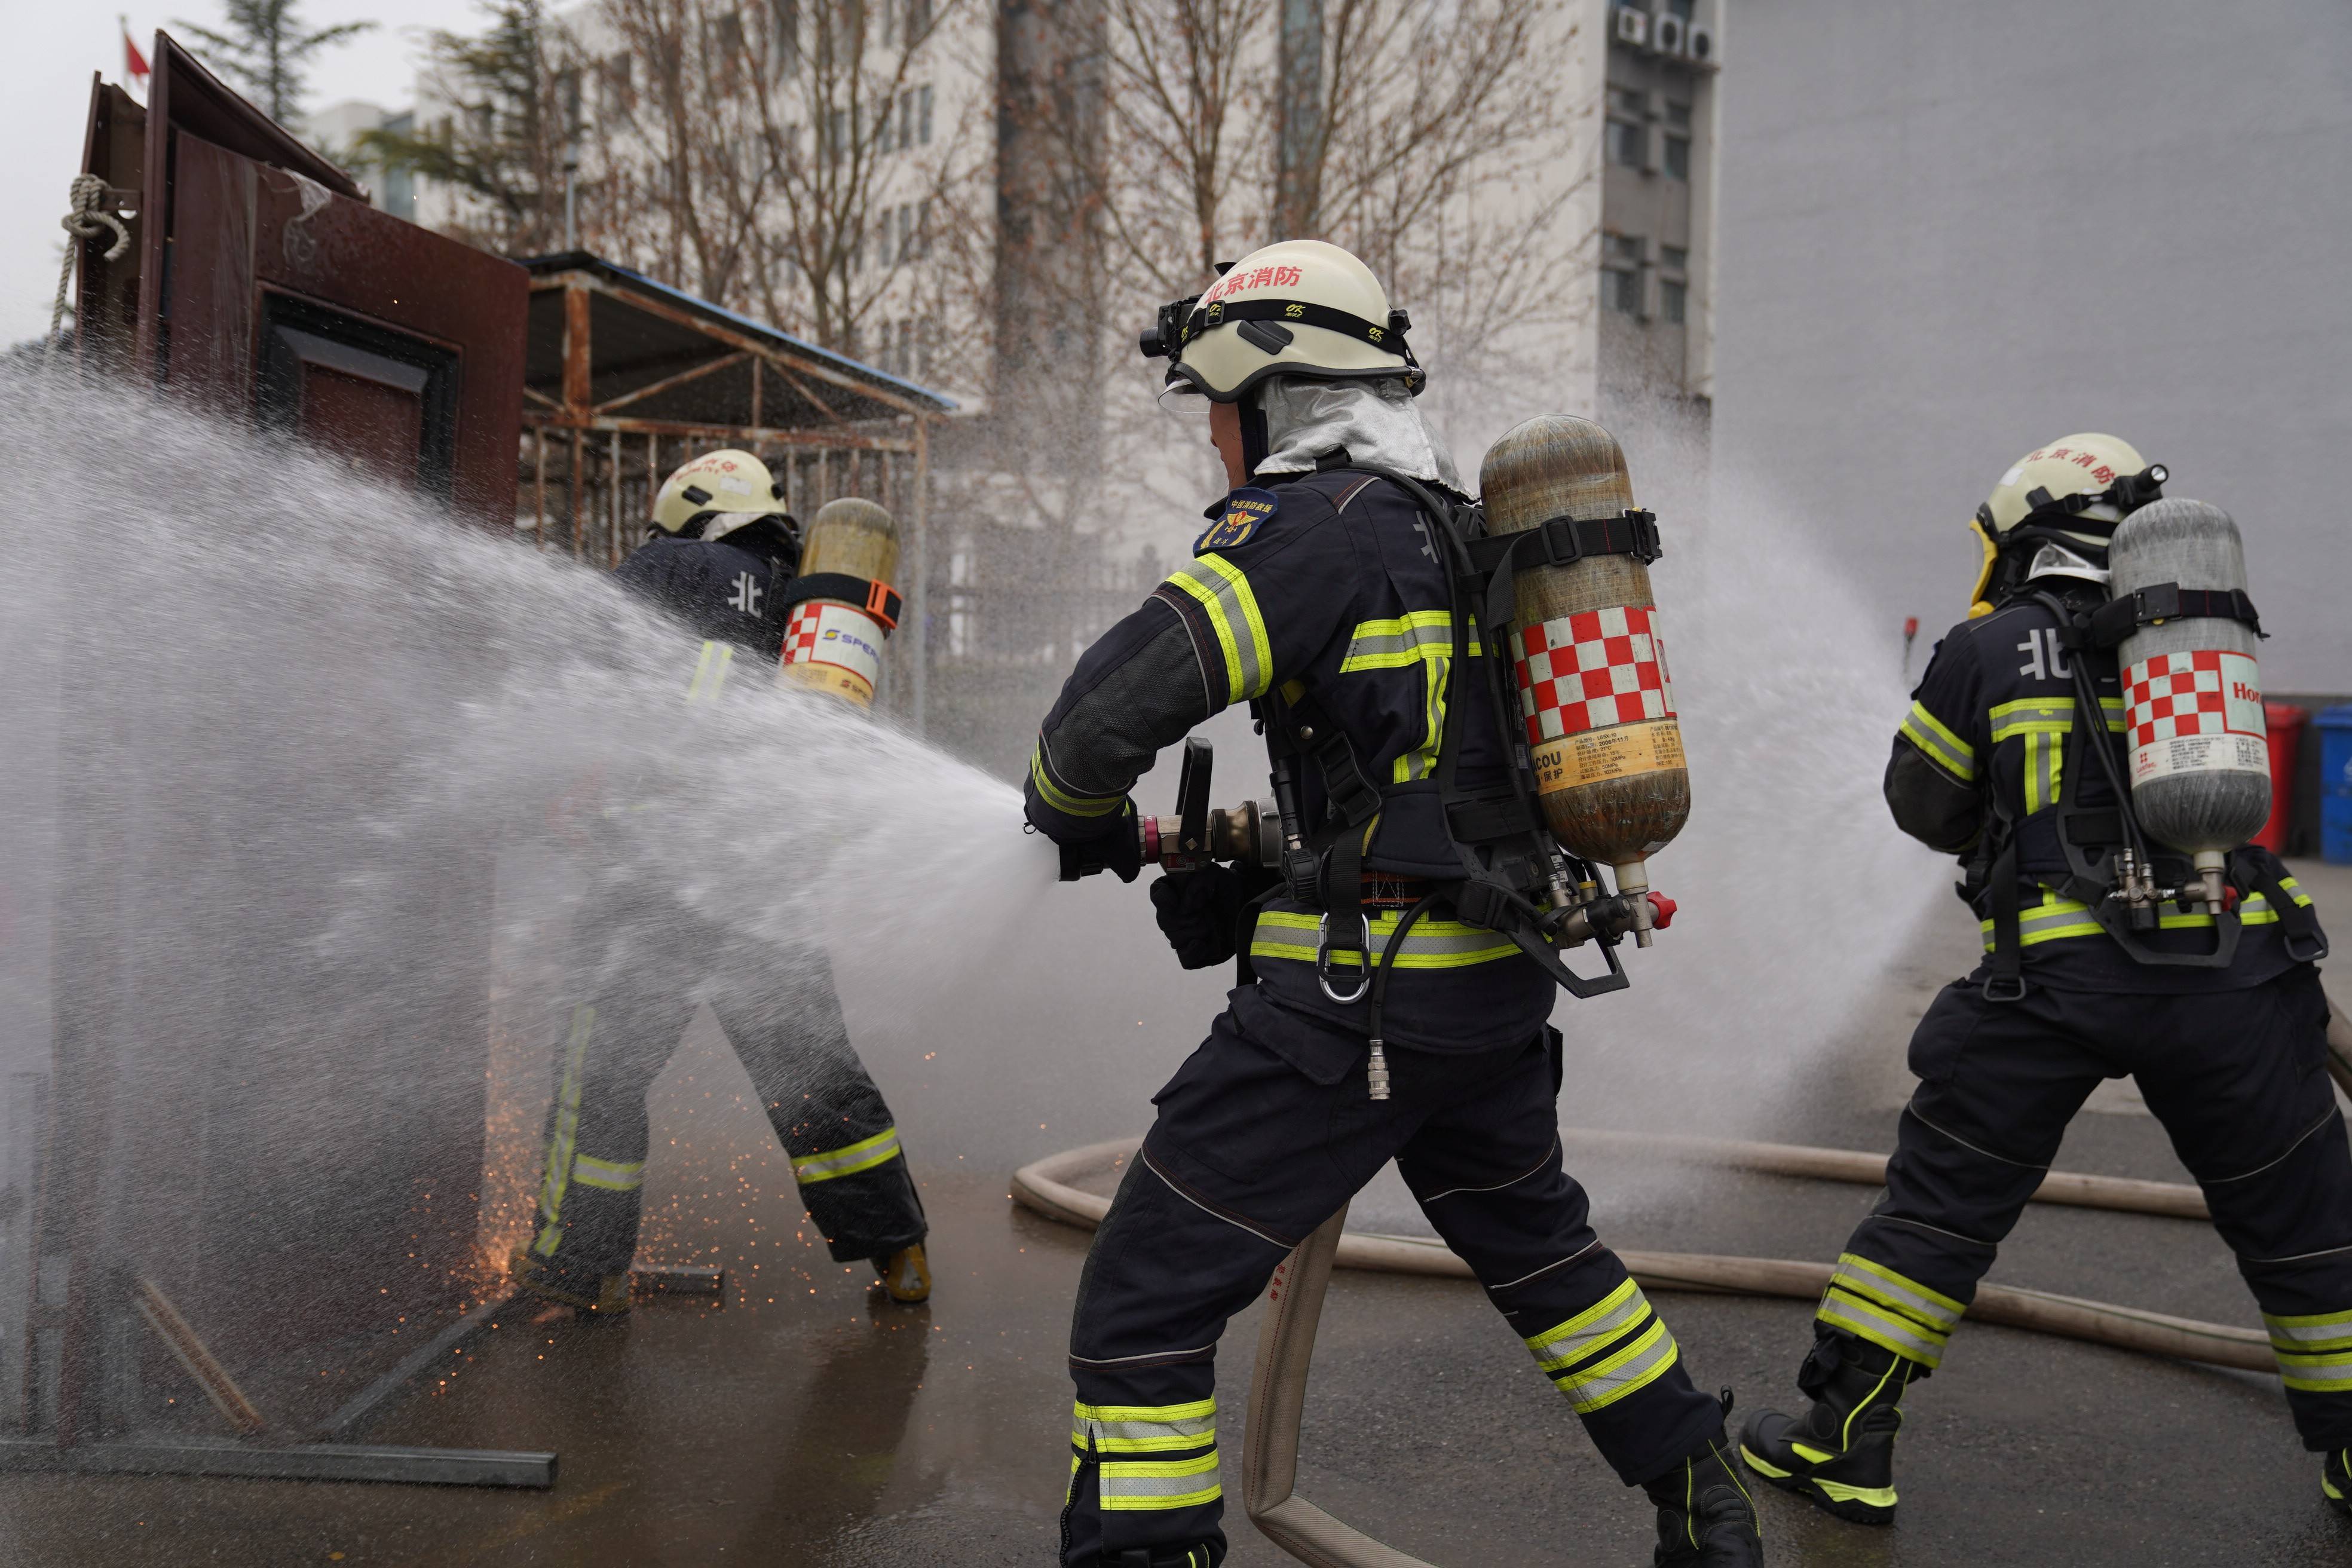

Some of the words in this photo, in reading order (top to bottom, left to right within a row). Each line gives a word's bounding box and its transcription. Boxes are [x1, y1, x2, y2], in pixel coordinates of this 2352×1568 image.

[1204, 266, 1303, 305] 北京消防
[1285, 304, 1306, 314] OK
[1368, 327, 1385, 339] OK
[2027, 448, 2116, 485] 北京消防
[1231, 500, 1273, 513] 中国消防救援
[1598, 736, 1629, 746] 2006年11月
